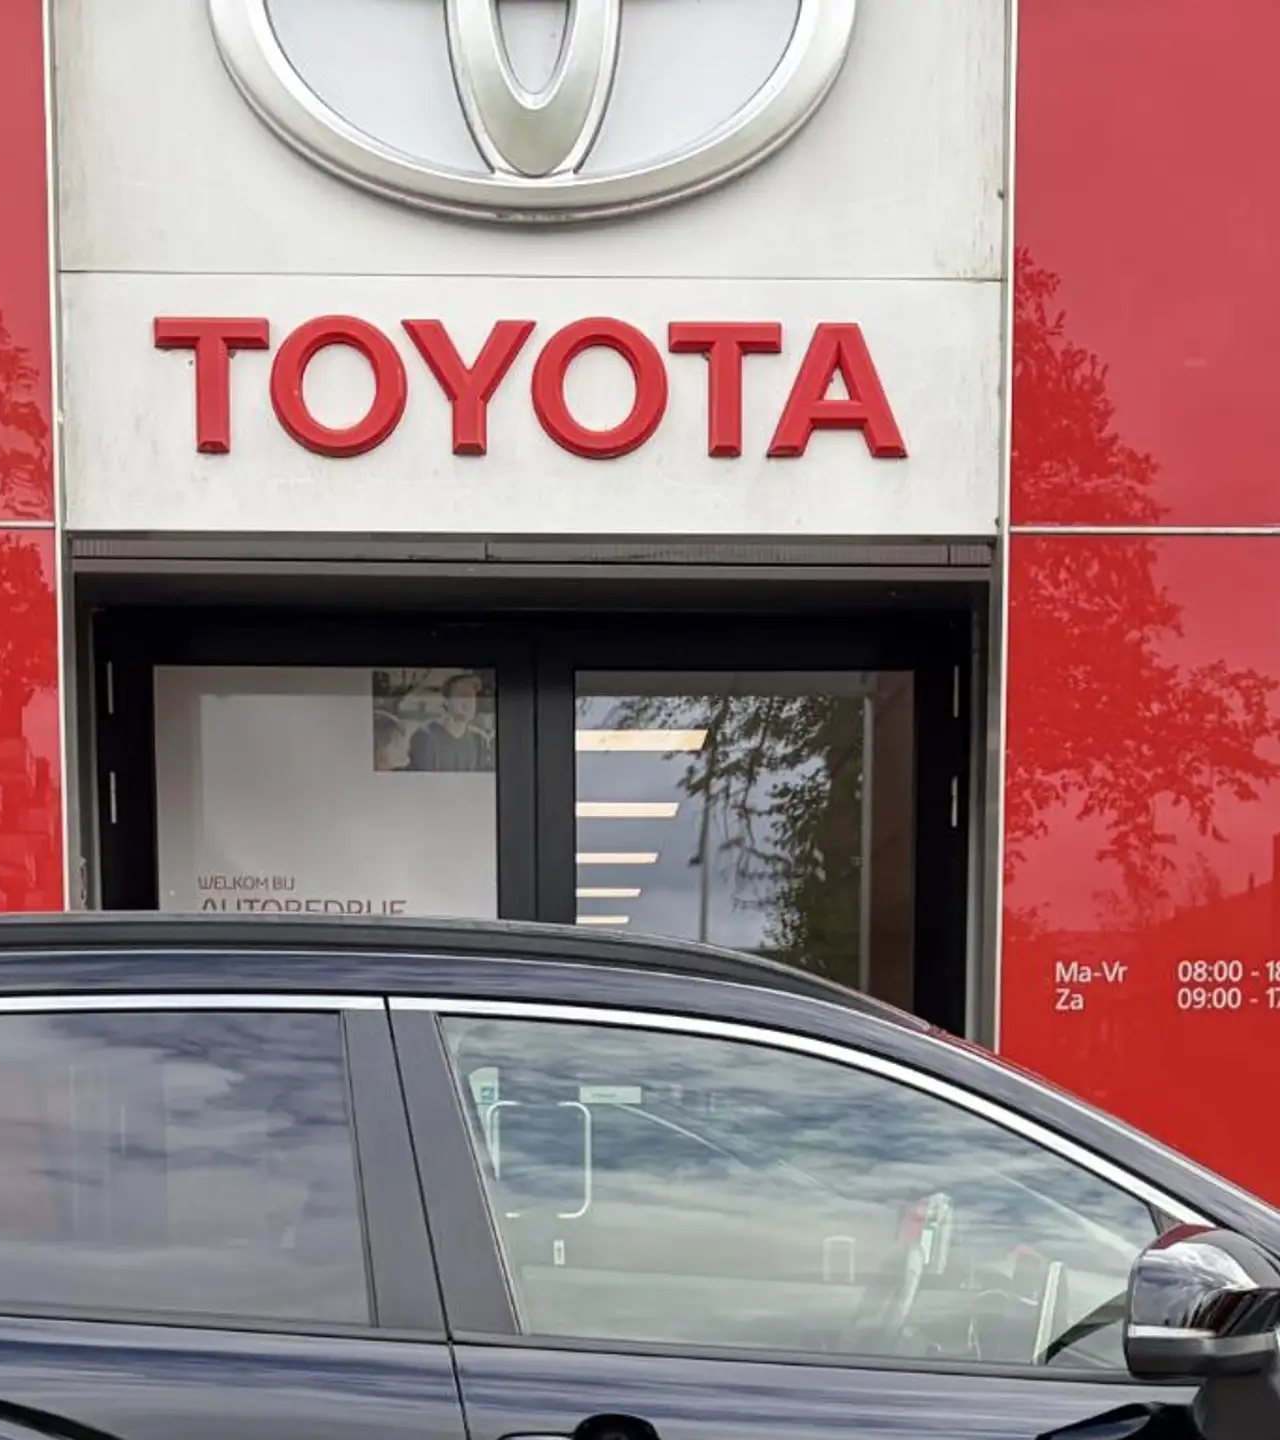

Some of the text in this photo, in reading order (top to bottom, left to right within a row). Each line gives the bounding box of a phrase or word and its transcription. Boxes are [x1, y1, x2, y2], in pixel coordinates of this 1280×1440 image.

[153, 314, 908, 459] TOYOTA
[197, 875, 269, 890] WELKOM
[1054, 961, 1128, 983] Ma-Vr
[1177, 960, 1243, 982] 08:00
[1054, 988, 1085, 1010] Za
[1177, 987, 1242, 1009] 09:00
